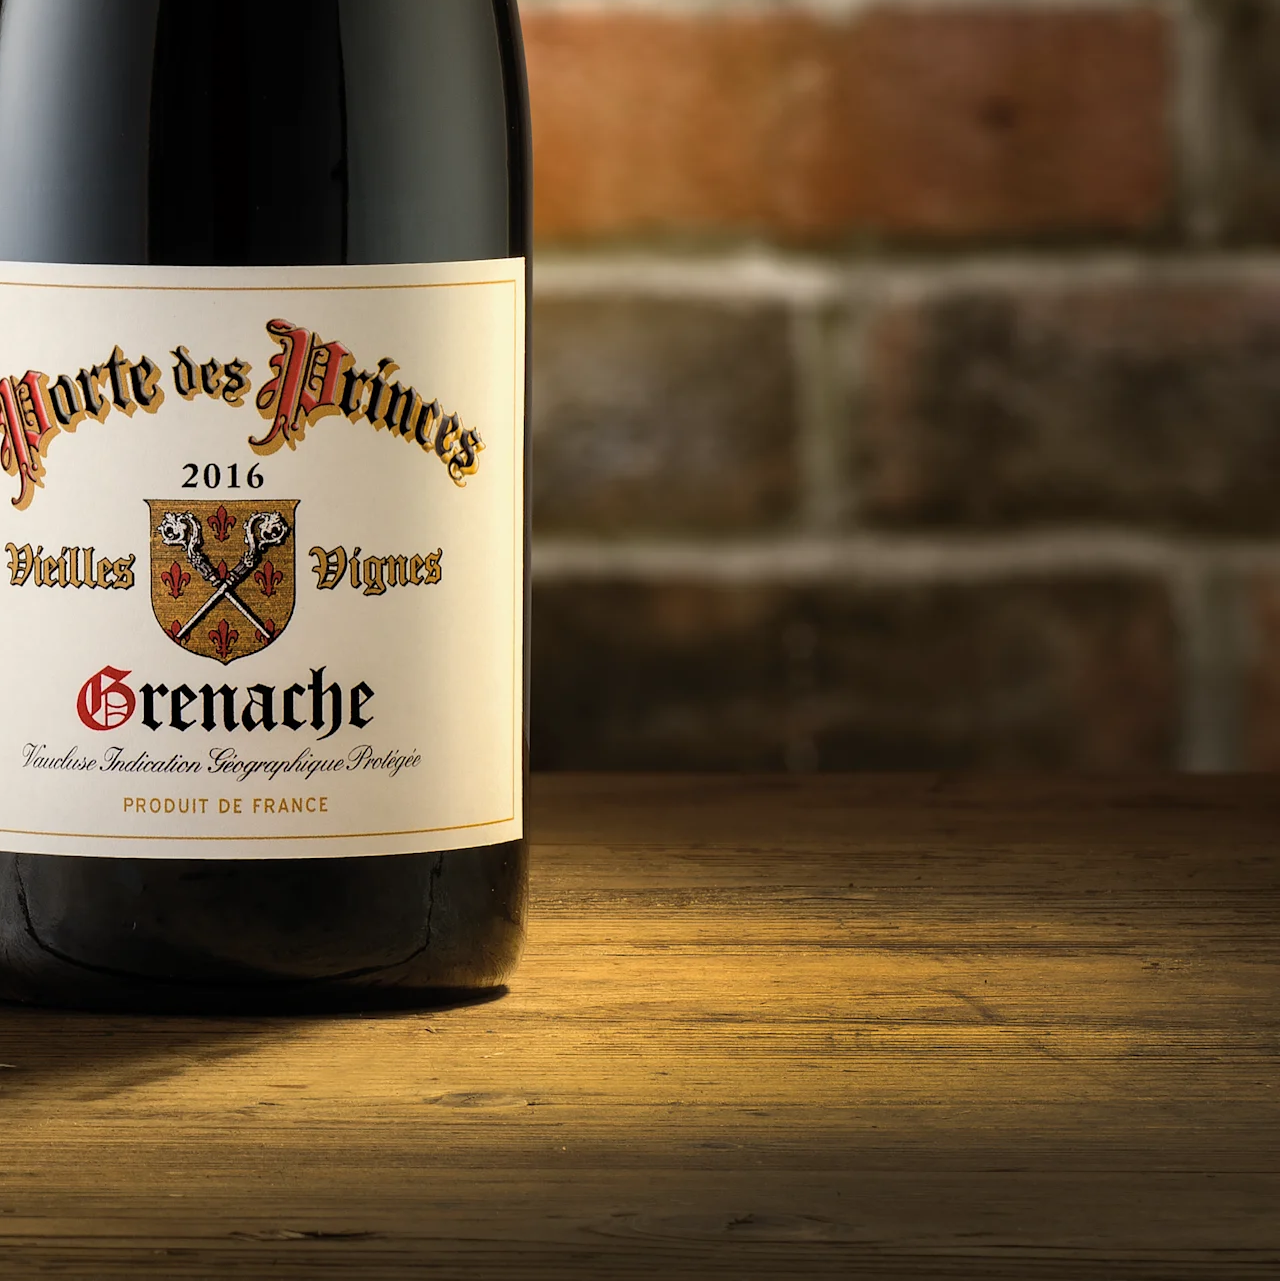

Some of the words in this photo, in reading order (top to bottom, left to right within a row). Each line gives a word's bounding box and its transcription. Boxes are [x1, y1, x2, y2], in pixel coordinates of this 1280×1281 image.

[169, 344, 252, 406] des
[248, 317, 487, 489] Princes
[181, 461, 265, 490] 2016
[4, 541, 137, 592] Vieilles
[308, 545, 444, 597] Vignes
[75, 665, 376, 742] Grenache
[21, 743, 98, 772] Vaucluse
[99, 747, 203, 774] Indication
[206, 746, 344, 783] Géographique
[345, 743, 423, 779] Protégée
[123, 796, 210, 814] PRODUIT
[218, 797, 243, 814] DE
[252, 796, 329, 813] FRANCE
